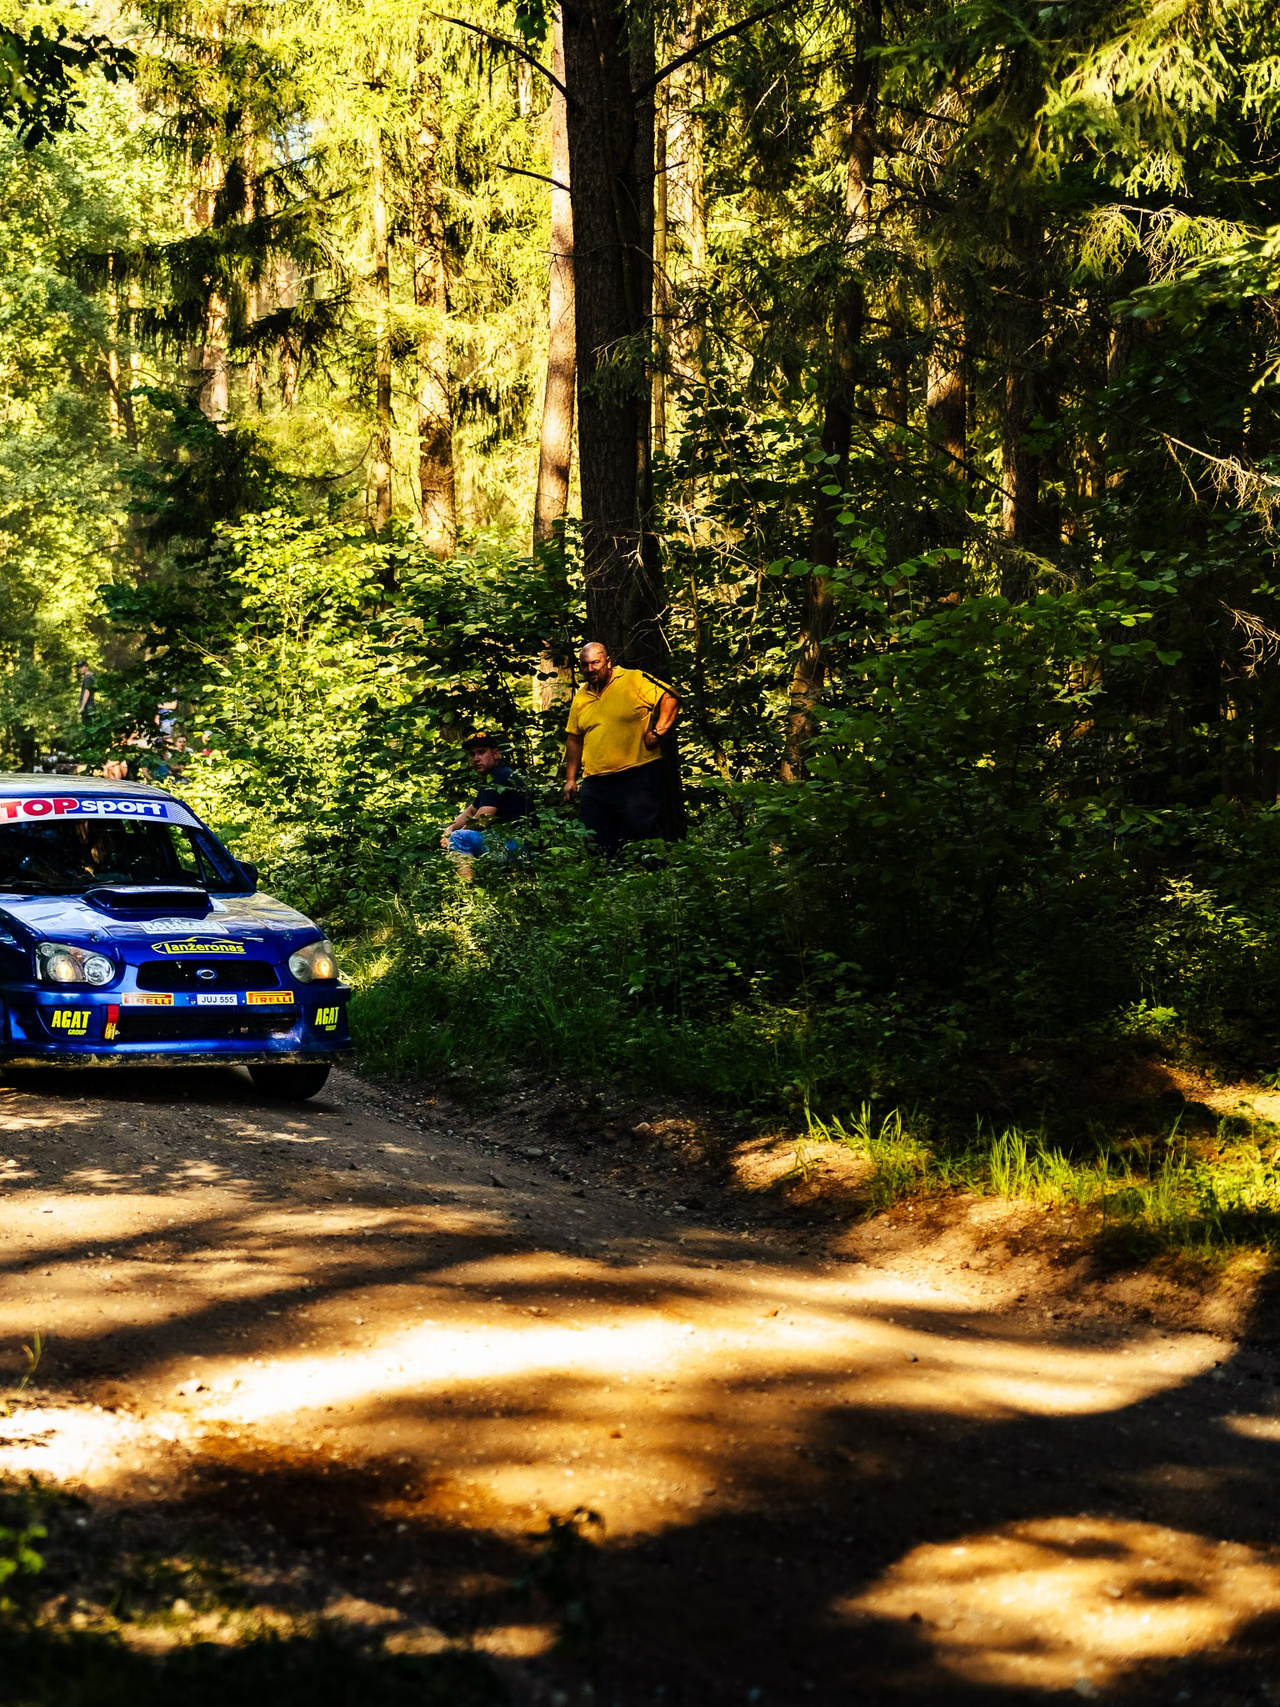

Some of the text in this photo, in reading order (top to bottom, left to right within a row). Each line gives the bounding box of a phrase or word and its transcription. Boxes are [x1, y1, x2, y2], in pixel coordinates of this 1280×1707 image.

[163, 942, 247, 954] Lanžeronas
[124, 993, 172, 1005] PIRELLI
[201, 996, 234, 1004] JUJ 555
[248, 992, 292, 1004] PIRELLI
[51, 1010, 92, 1028] AGAT
[314, 1006, 340, 1025] AGAT
